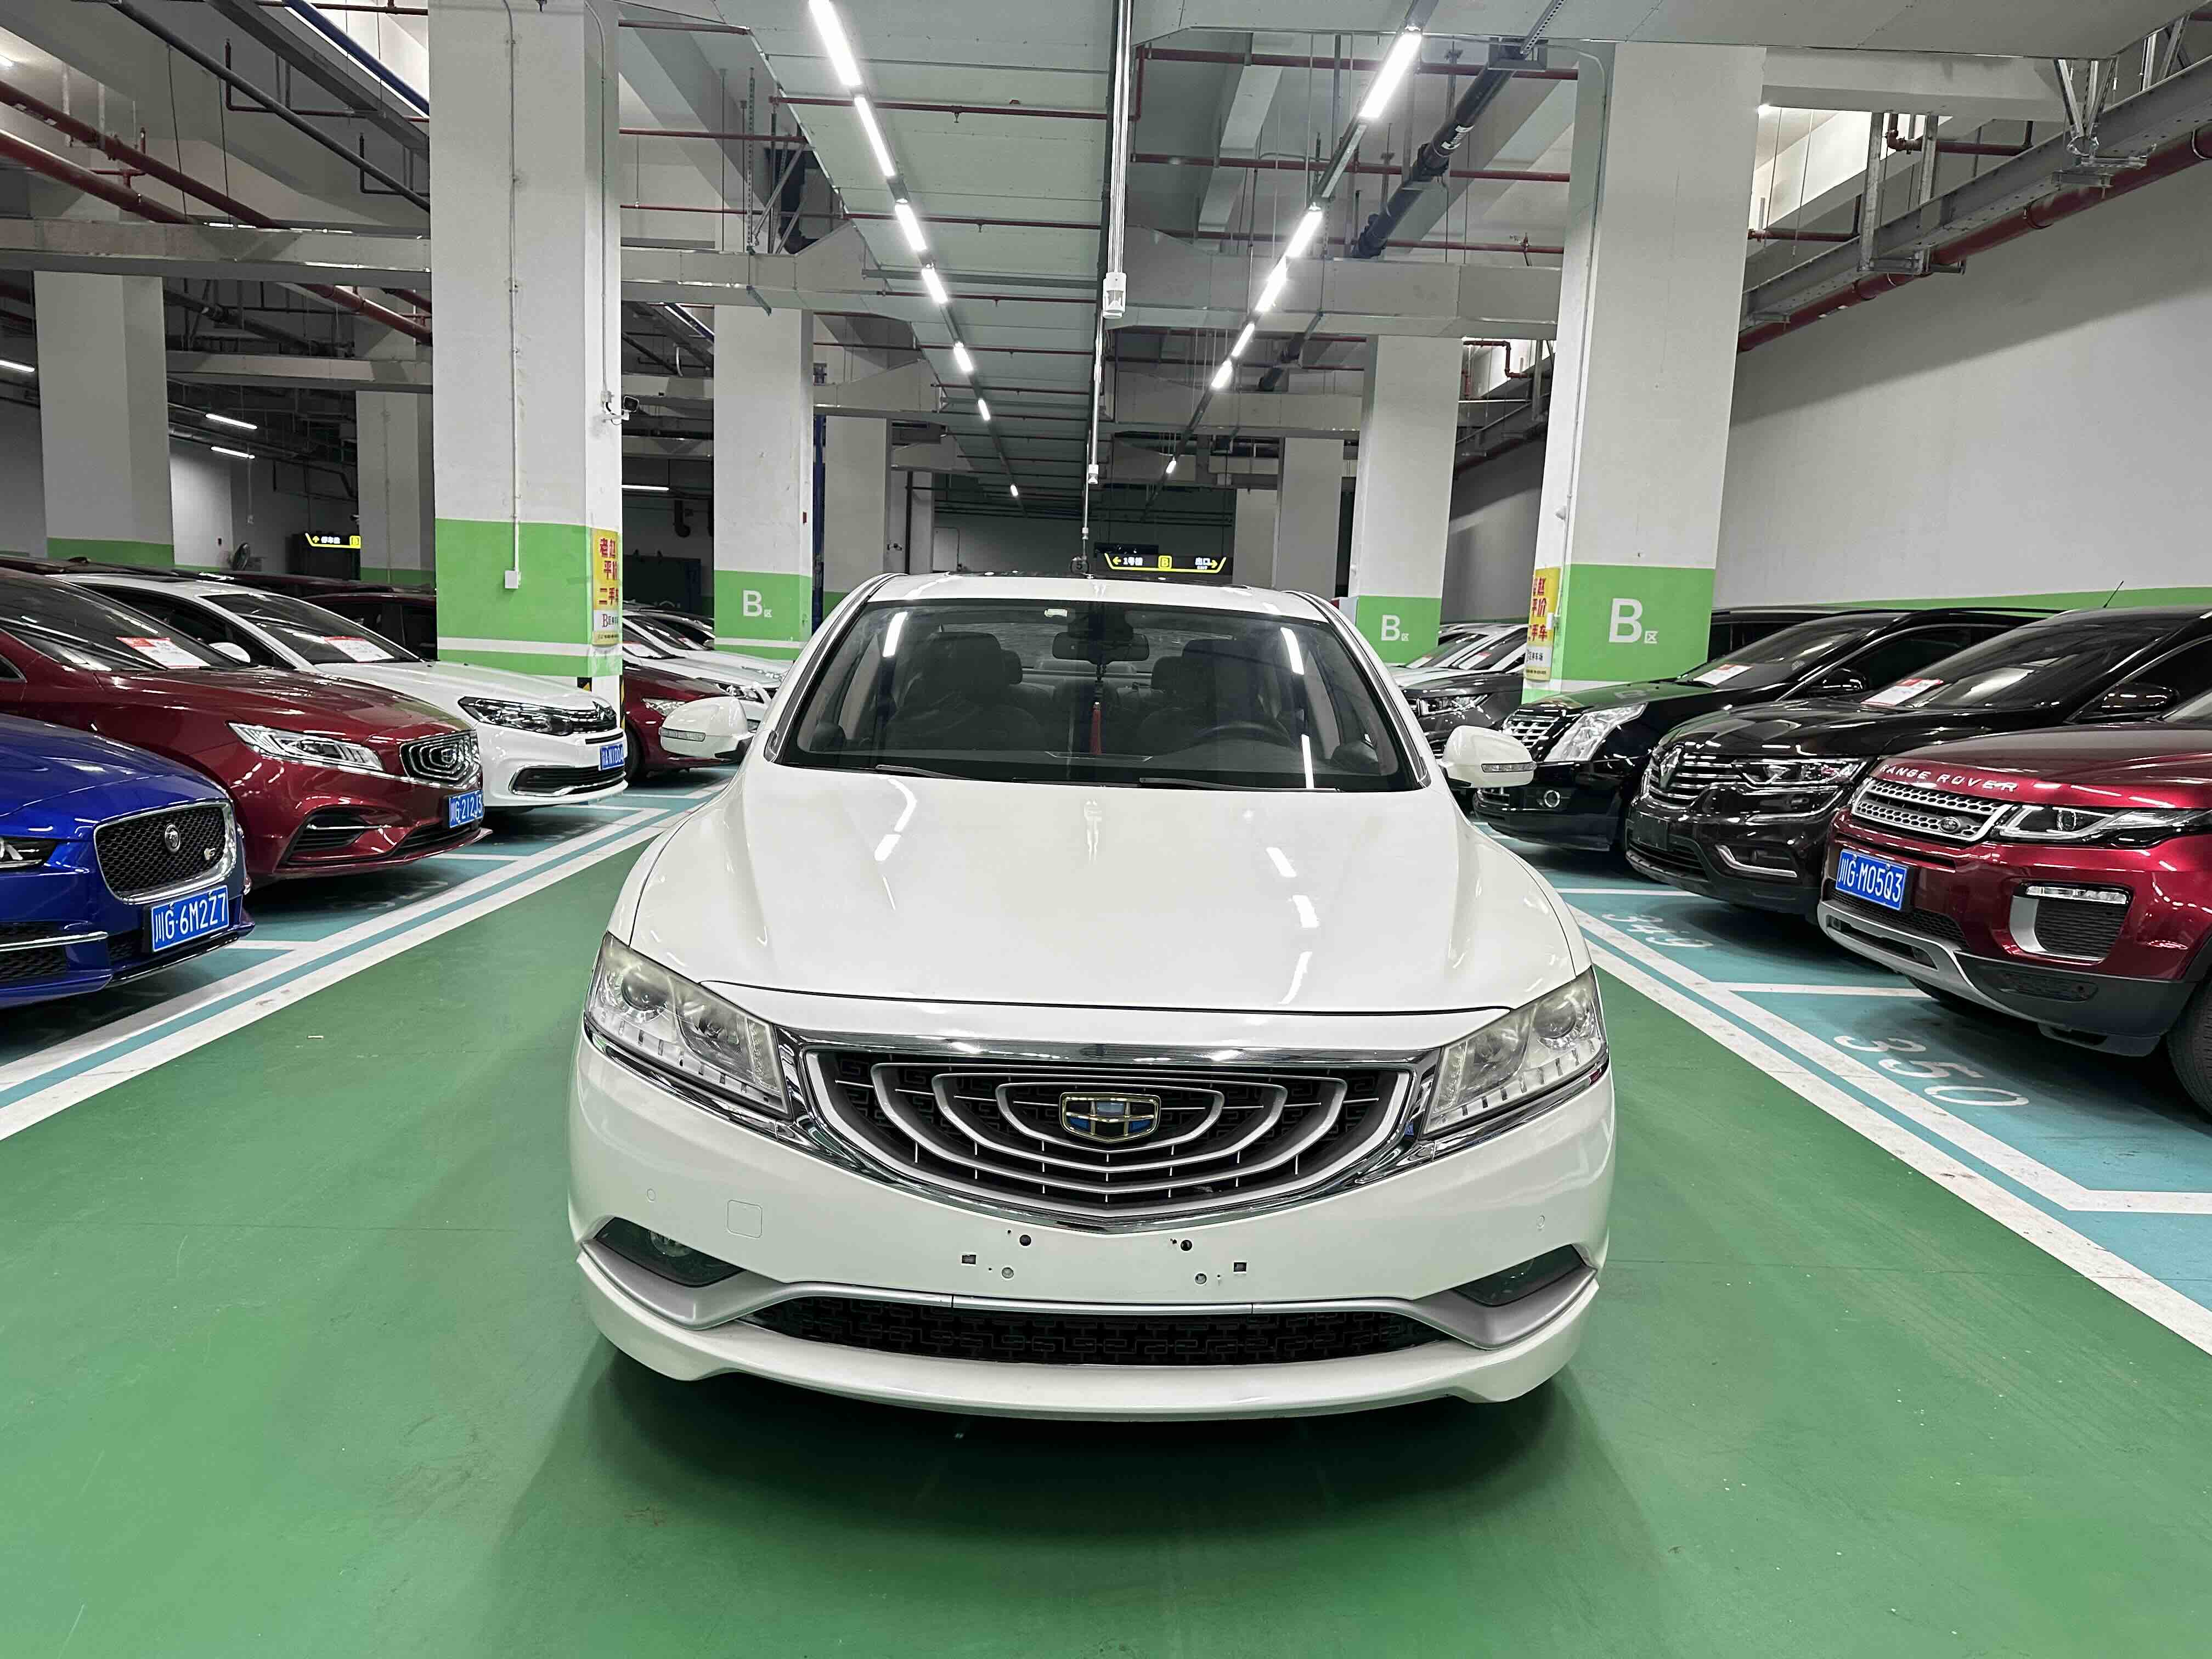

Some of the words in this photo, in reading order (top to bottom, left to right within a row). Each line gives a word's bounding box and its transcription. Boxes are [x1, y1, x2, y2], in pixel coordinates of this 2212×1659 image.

[1195, 557, 1210, 566] 出口
[743, 590, 773, 618] B区
[1381, 614, 1409, 641] B区
[1528, 624, 1548, 641] 手车
[1609, 598, 1658, 644] B区
[1880, 764, 1932, 780] RANGE
[1937, 774, 2018, 792] ROVER
[1833, 1035, 2030, 1107] 350
